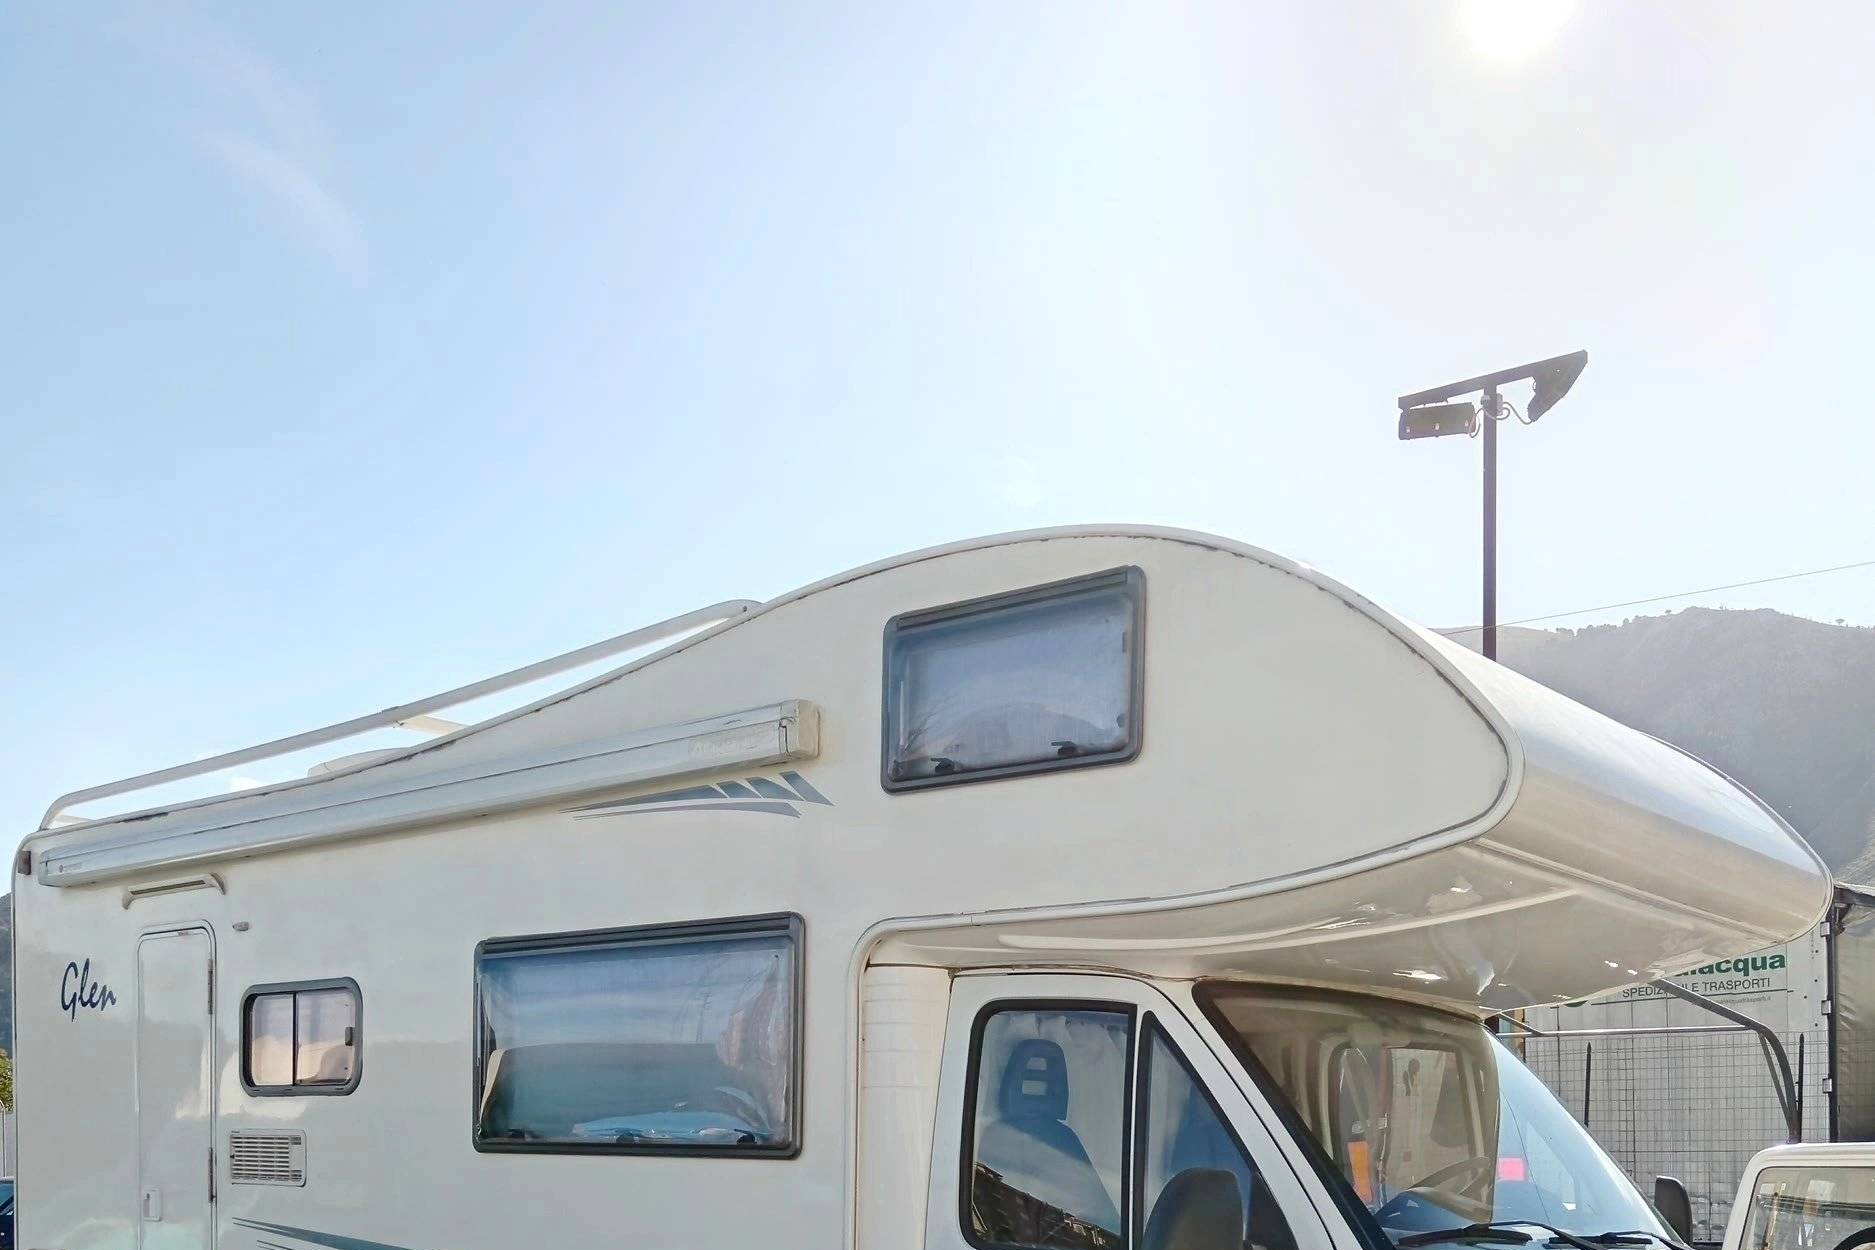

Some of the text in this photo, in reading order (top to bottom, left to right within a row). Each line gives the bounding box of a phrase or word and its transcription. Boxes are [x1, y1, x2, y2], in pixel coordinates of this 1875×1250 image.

[1675, 953, 1786, 976] acqua
[61, 957, 117, 1023] Glen
[1622, 982, 1688, 998] SPEDIZI
[1701, 977, 1771, 993] TRASPORTI
